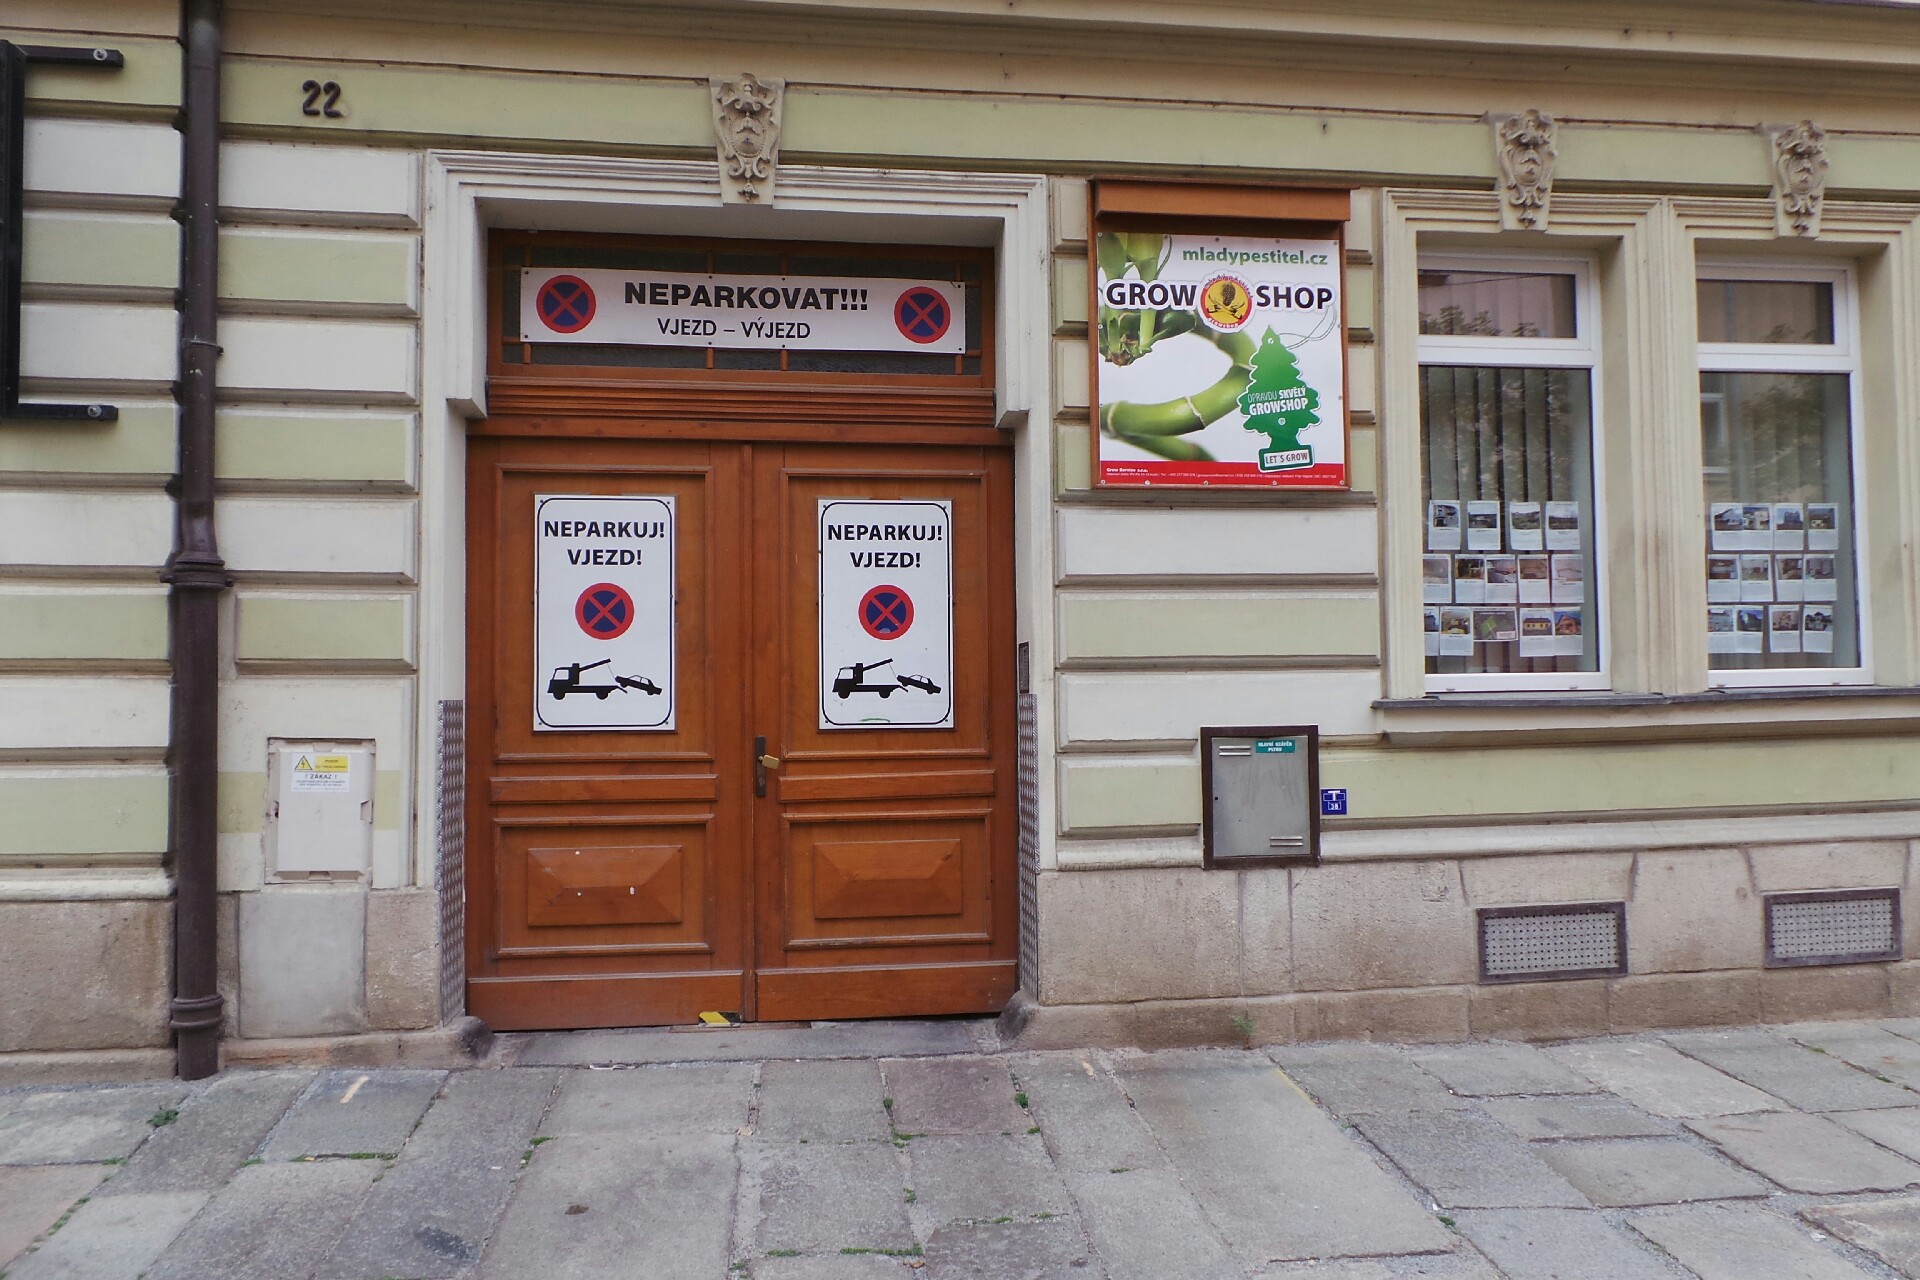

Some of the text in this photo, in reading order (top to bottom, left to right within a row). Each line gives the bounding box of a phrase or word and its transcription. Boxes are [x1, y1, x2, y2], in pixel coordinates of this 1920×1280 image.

[302, 79, 342, 118] 22
[1183, 247, 1328, 265] mladypestitel.cz
[624, 281, 868, 311] NEPARKOVAT!!!
[1106, 282, 1333, 310] GROW SHOP
[657, 317, 717, 336] VJEZD
[740, 315, 811, 339] VÝJEZD
[1247, 385, 1307, 404] OPRAVDU SKVĚLÝ
[1249, 397, 1309, 416] GROWSHOP
[1286, 452, 1308, 462] GROW
[544, 520, 665, 539] NEPARKUJ!
[827, 524, 943, 541] NEPARKUJ!
[567, 549, 642, 566] VJEZD!
[850, 552, 921, 568] VJEZD!
